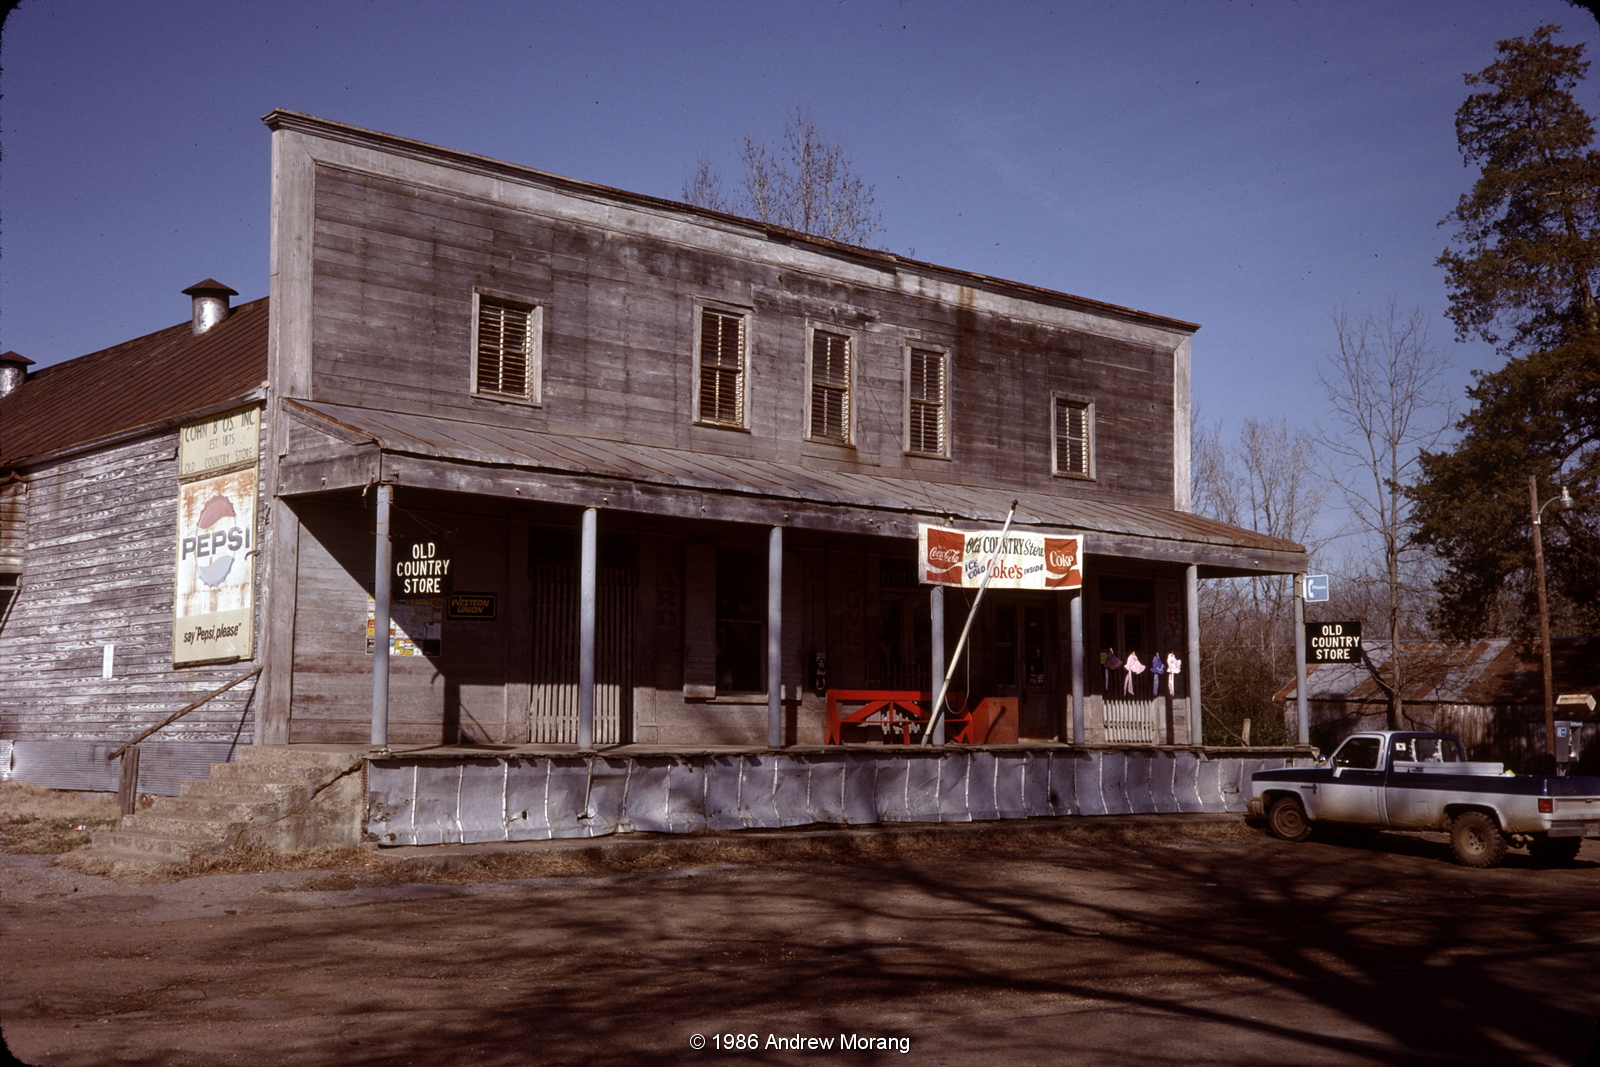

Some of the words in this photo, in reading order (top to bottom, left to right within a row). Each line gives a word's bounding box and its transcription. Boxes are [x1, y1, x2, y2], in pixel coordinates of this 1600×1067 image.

[184, 461, 196, 473] OLD
[204, 453, 229, 468] COUNTRY
[236, 447, 252, 461] STORE
[182, 526, 250, 560] PEPSI
[412, 542, 435, 559] OLD
[1023, 538, 1044, 557] Store
[965, 559, 979, 573] ICE
[1050, 550, 1074, 567] Coke
[396, 559, 450, 576] COUNTRY
[967, 565, 986, 580] COLD
[1023, 564, 1044, 575] INSIDE
[403, 578, 441, 593] STORE
[451, 599, 490, 608] WESTERN
[457, 606, 484, 614] UNION
[183, 630, 196, 646] say
[1322, 625, 1343, 636] OLD
[1311, 636, 1360, 648] COUNTRY
[1316, 648, 1351, 660] STORE
